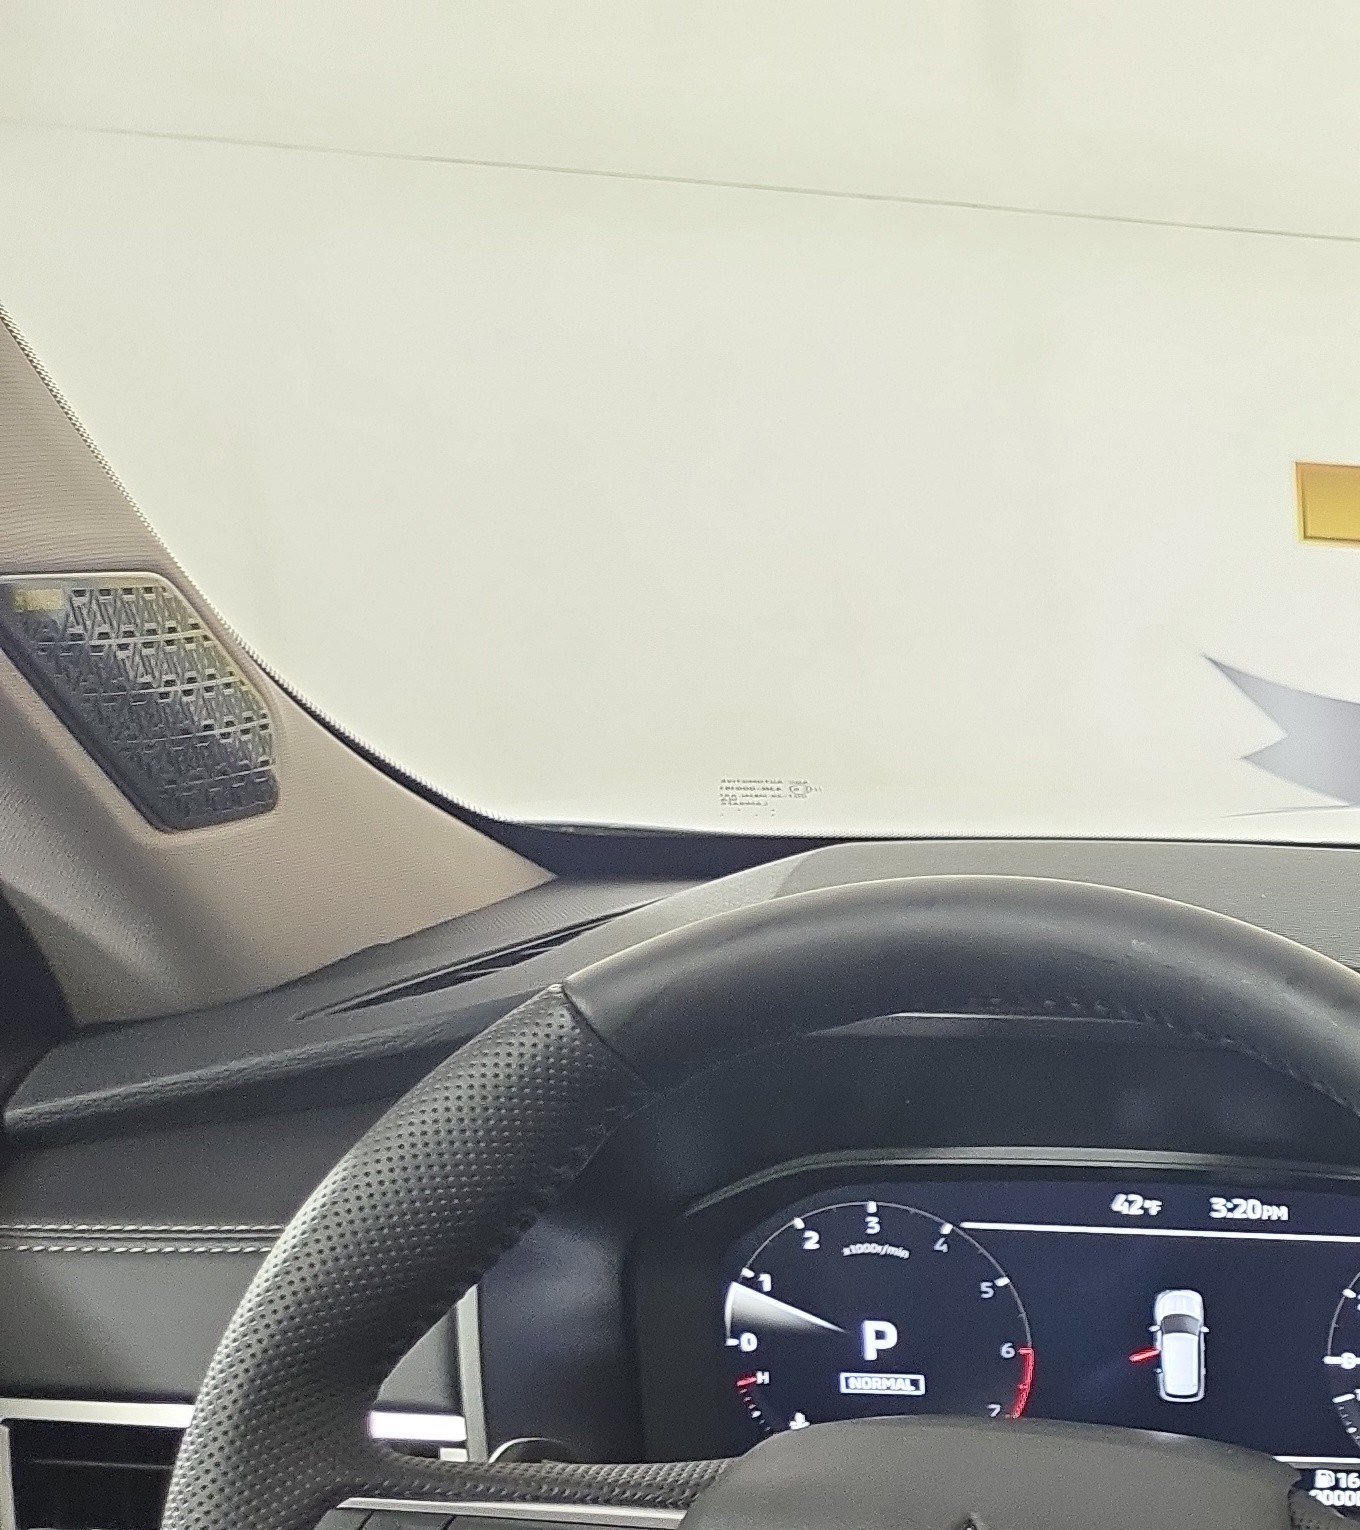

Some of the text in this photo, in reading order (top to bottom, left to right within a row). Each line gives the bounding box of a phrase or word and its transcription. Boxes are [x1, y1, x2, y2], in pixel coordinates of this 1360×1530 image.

[865, 1216, 880, 1234] 3
[803, 1230, 820, 1250] 2
[934, 1238, 948, 1253] 4
[758, 1274, 772, 1292] 1
[980, 1282, 994, 1299] 5
[738, 1332, 758, 1352] 0
[863, 1320, 898, 1361] P
[1001, 1342, 1015, 1359] 6
[756, 1372, 770, 1385] H
[849, 1377, 915, 1391] NORMAL
[987, 1404, 1001, 1418] 7
[1337, 1473, 1359, 1489] 16
